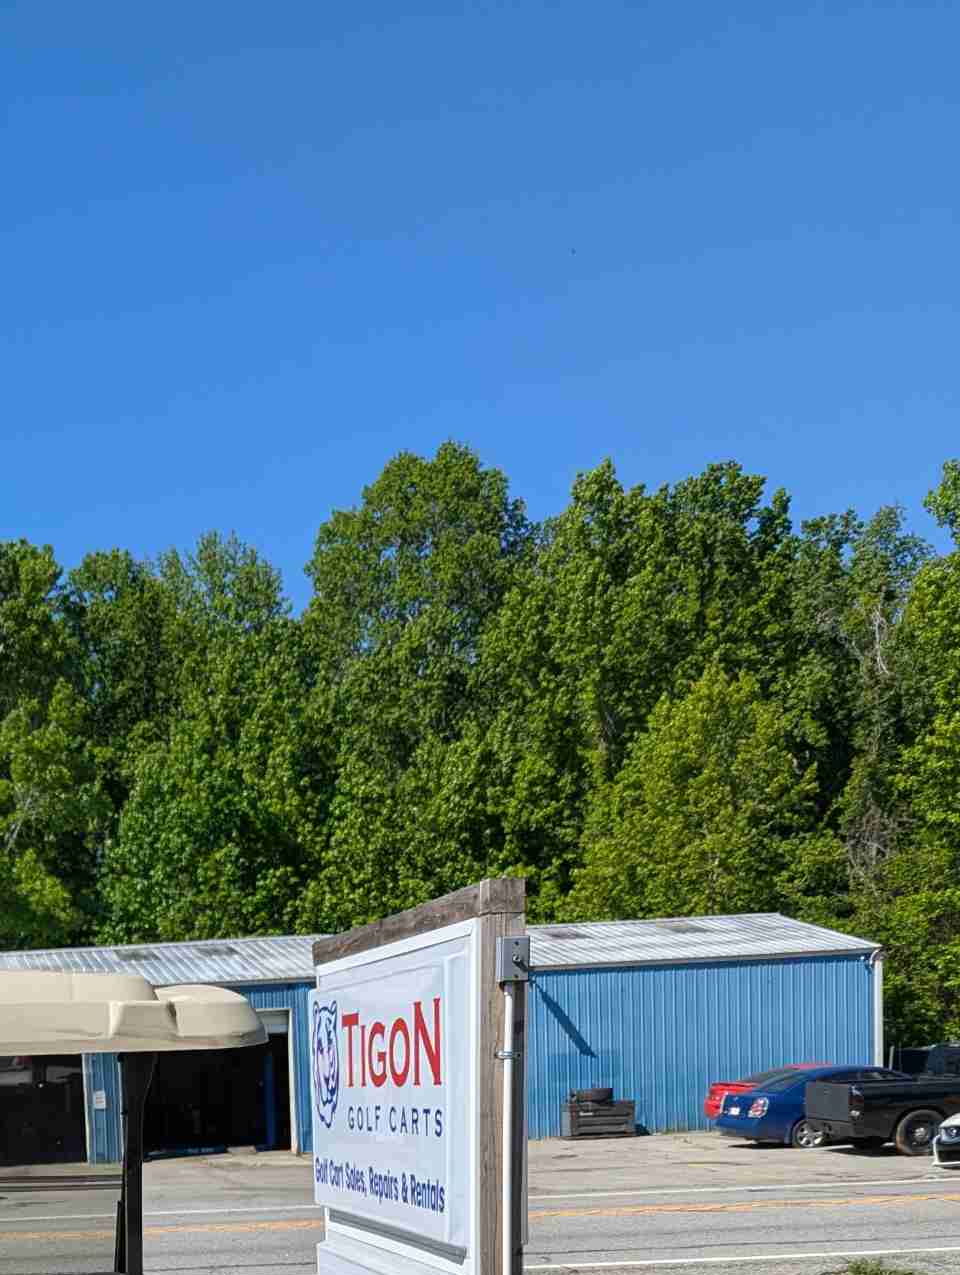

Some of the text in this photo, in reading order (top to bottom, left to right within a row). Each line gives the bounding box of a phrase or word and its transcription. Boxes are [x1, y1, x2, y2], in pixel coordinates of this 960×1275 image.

[347, 1106, 443, 1137] GOLF CARTS
[315, 1157, 445, 1213] Golf Cart Sales, Repairs & Rentals
